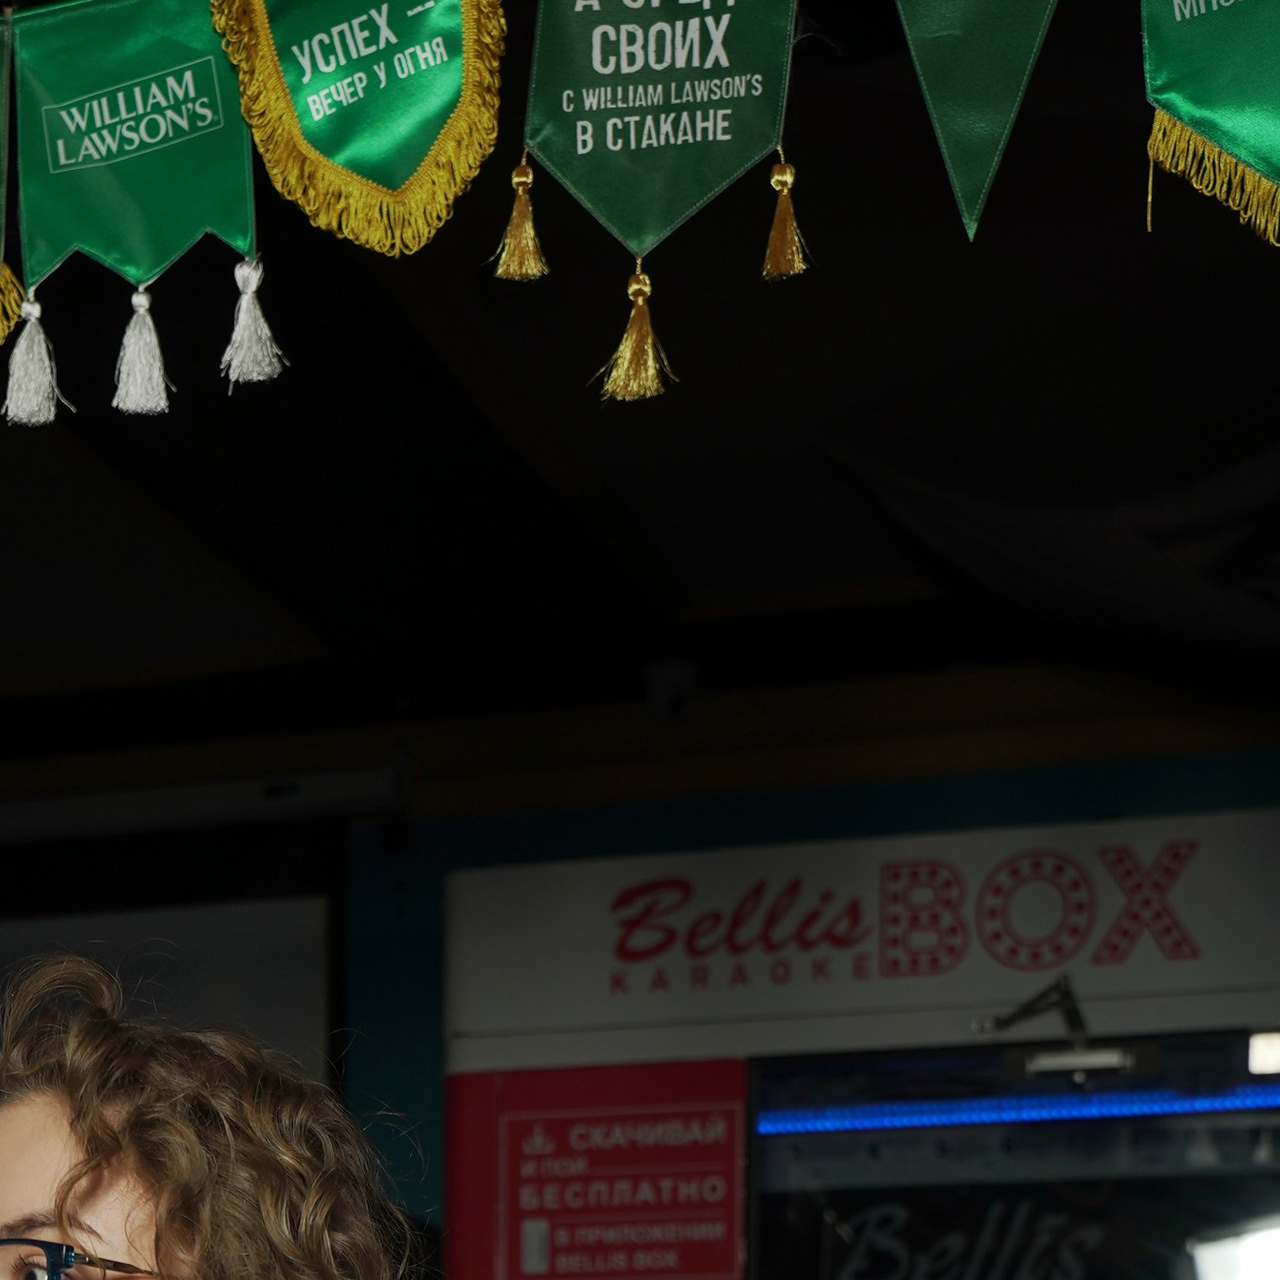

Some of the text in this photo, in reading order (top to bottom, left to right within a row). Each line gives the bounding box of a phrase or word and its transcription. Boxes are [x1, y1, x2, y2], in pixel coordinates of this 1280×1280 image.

[290, 2, 399, 85] УСПЕХ
[592, 13, 732, 74] СВОИХ
[59, 69, 197, 135] WILLIAM
[306, 36, 449, 121] ВЕЧЕР У ОГНЯ
[582, 84, 663, 111] WILLIAM
[671, 73, 763, 104] LAWSON'S
[56, 97, 214, 166] LAWSON'S
[576, 108, 733, 155] В СТАКАНЕ
[609, 839, 1201, 981] Bellis BOX
[609, 952, 872, 996] KARAOKE
[518, 1174, 727, 1211] БЕСПЛАТНО
